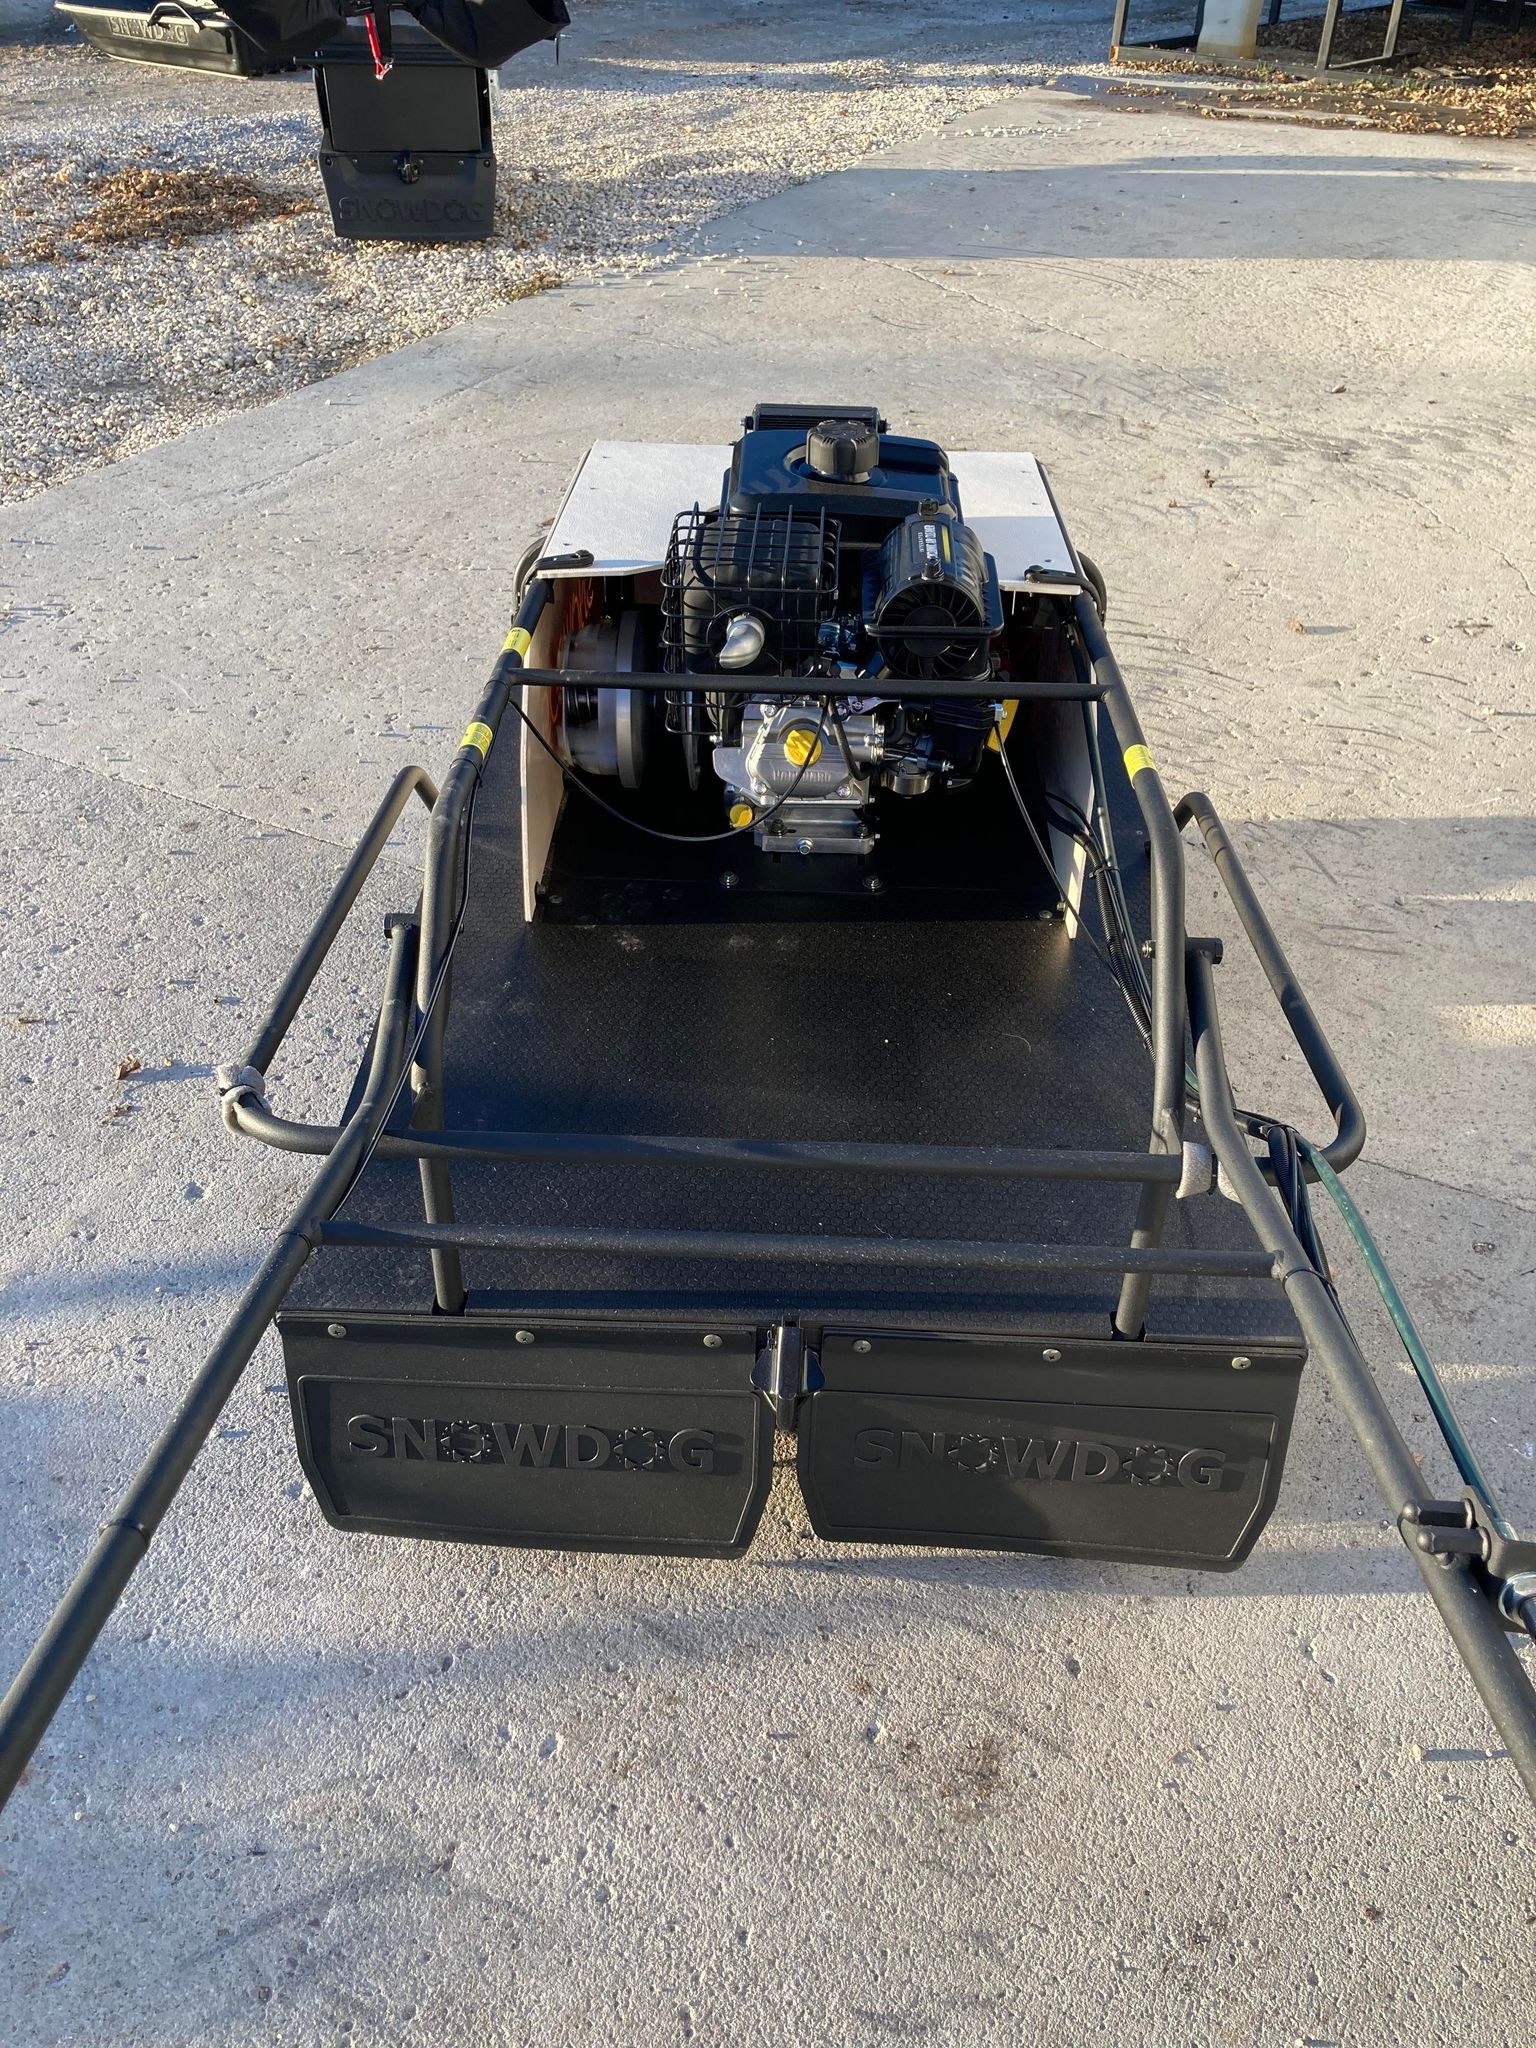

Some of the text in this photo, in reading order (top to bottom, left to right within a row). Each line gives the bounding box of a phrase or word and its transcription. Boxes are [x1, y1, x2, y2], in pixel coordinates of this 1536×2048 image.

[109, 15, 188, 43] SNOWDOG
[338, 197, 486, 223] SNOWDOG
[347, 1414, 715, 1473] SNOWDOG
[853, 1429, 1227, 1490] SNOWDOG
